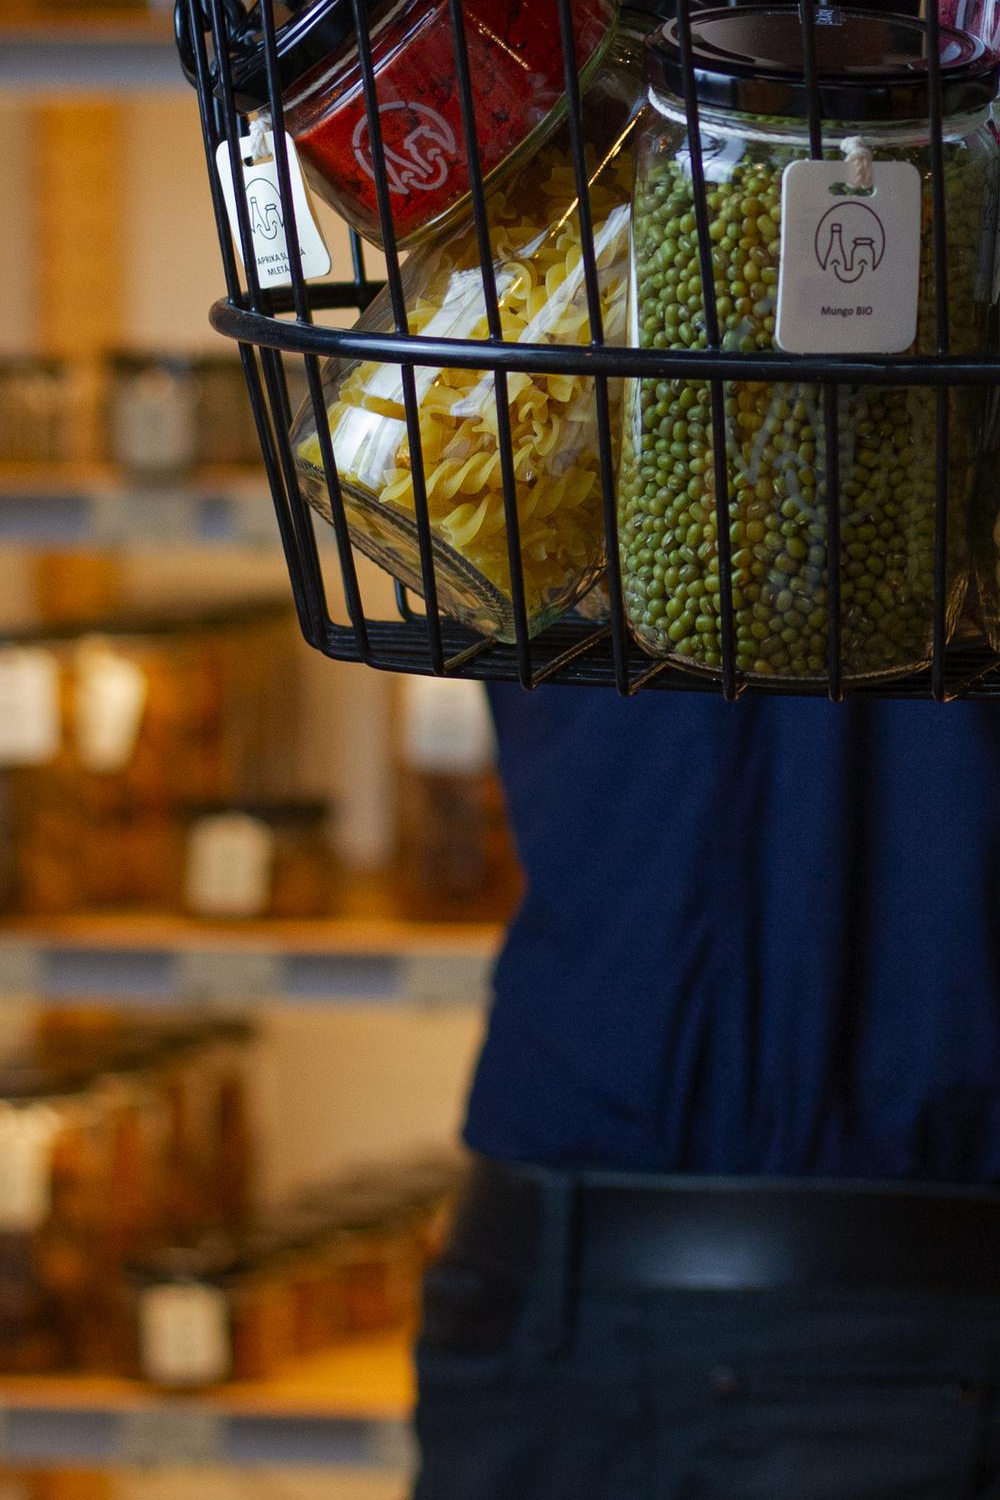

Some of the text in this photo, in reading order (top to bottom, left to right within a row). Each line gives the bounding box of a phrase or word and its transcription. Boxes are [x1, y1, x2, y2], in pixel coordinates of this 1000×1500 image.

[257, 254, 280, 266] APRIKA
[267, 263, 290, 276] MLETÁ
[820, 306, 873, 318] Mungo BIO
